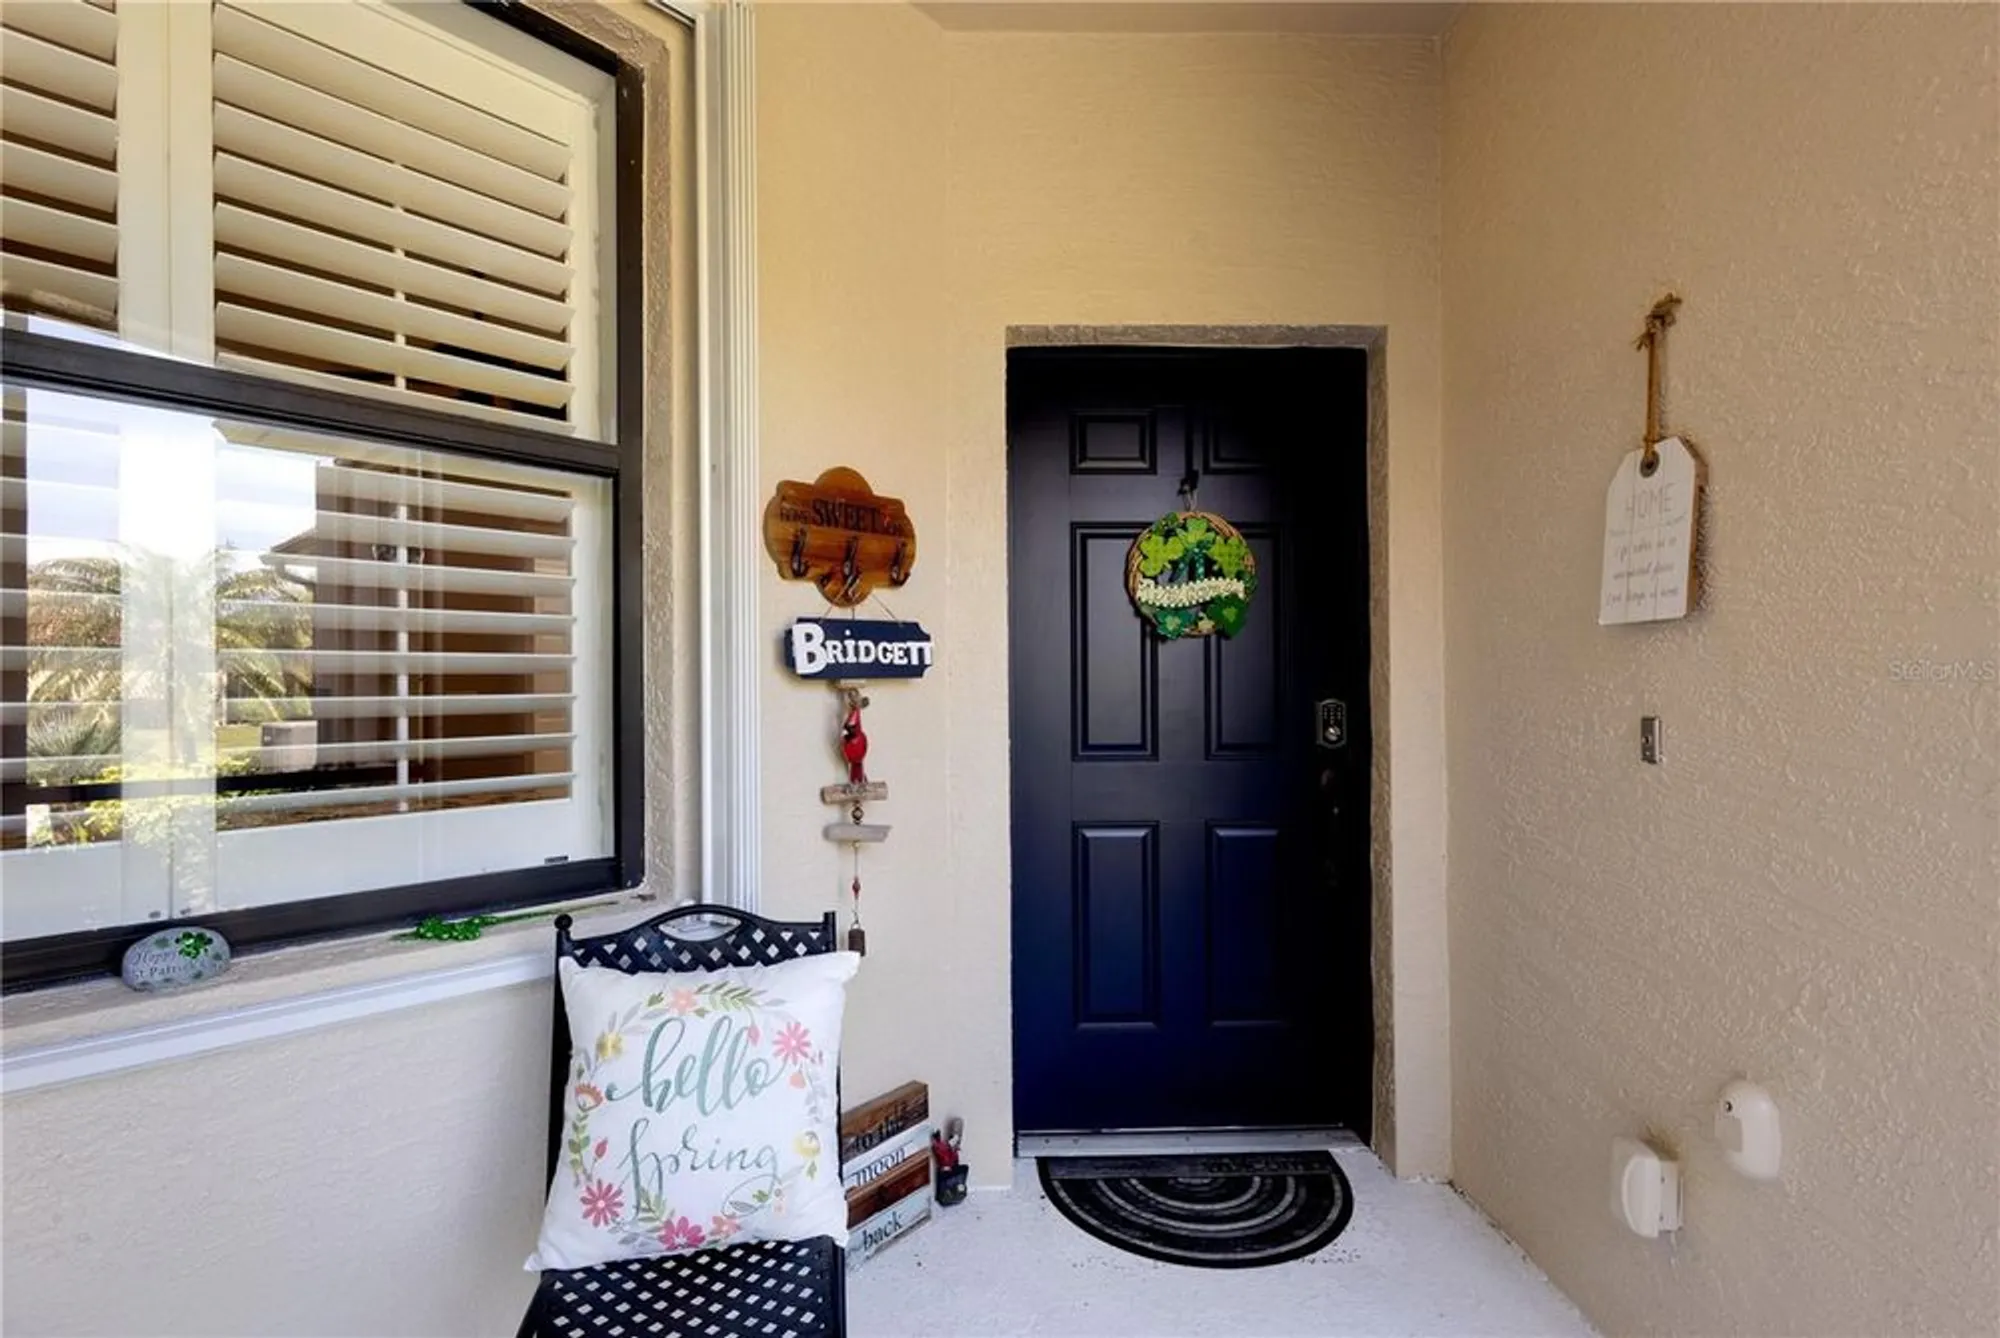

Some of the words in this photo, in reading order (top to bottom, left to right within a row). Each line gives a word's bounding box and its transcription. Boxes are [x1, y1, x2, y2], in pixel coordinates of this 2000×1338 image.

[812, 498, 880, 535] SWEET
[1625, 483, 1677, 519] HOME
[605, 1015, 788, 1118] hello
[612, 1117, 783, 1222] spring
[855, 1148, 907, 1187] moon
[862, 1210, 903, 1251] back
